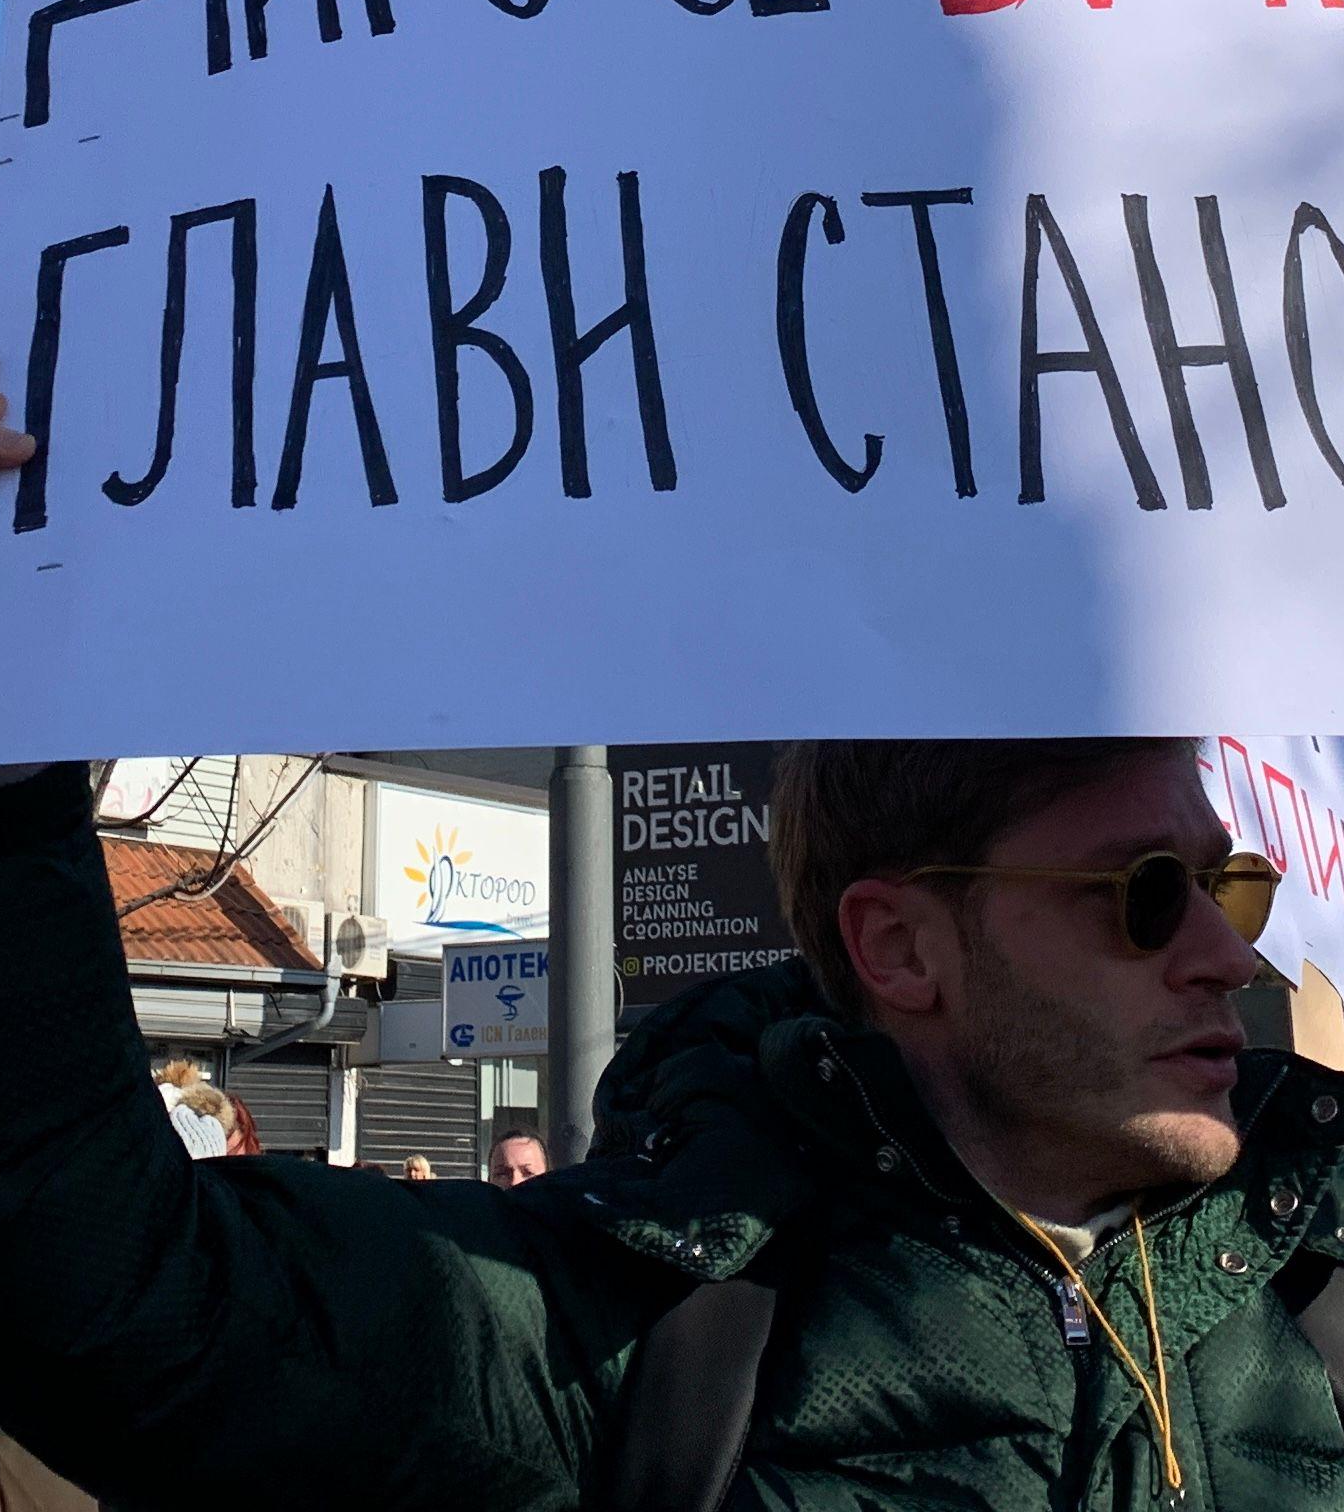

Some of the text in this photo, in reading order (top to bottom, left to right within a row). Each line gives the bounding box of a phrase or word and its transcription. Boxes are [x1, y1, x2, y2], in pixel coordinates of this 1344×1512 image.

[13, 166, 678, 534] ГЛАВИ
[622, 763, 743, 808] RETAIL
[622, 804, 770, 852] DESIGN
[622, 864, 699, 884] ANALYSE
[622, 884, 690, 903] DESIGN
[622, 900, 715, 922] PLANNING
